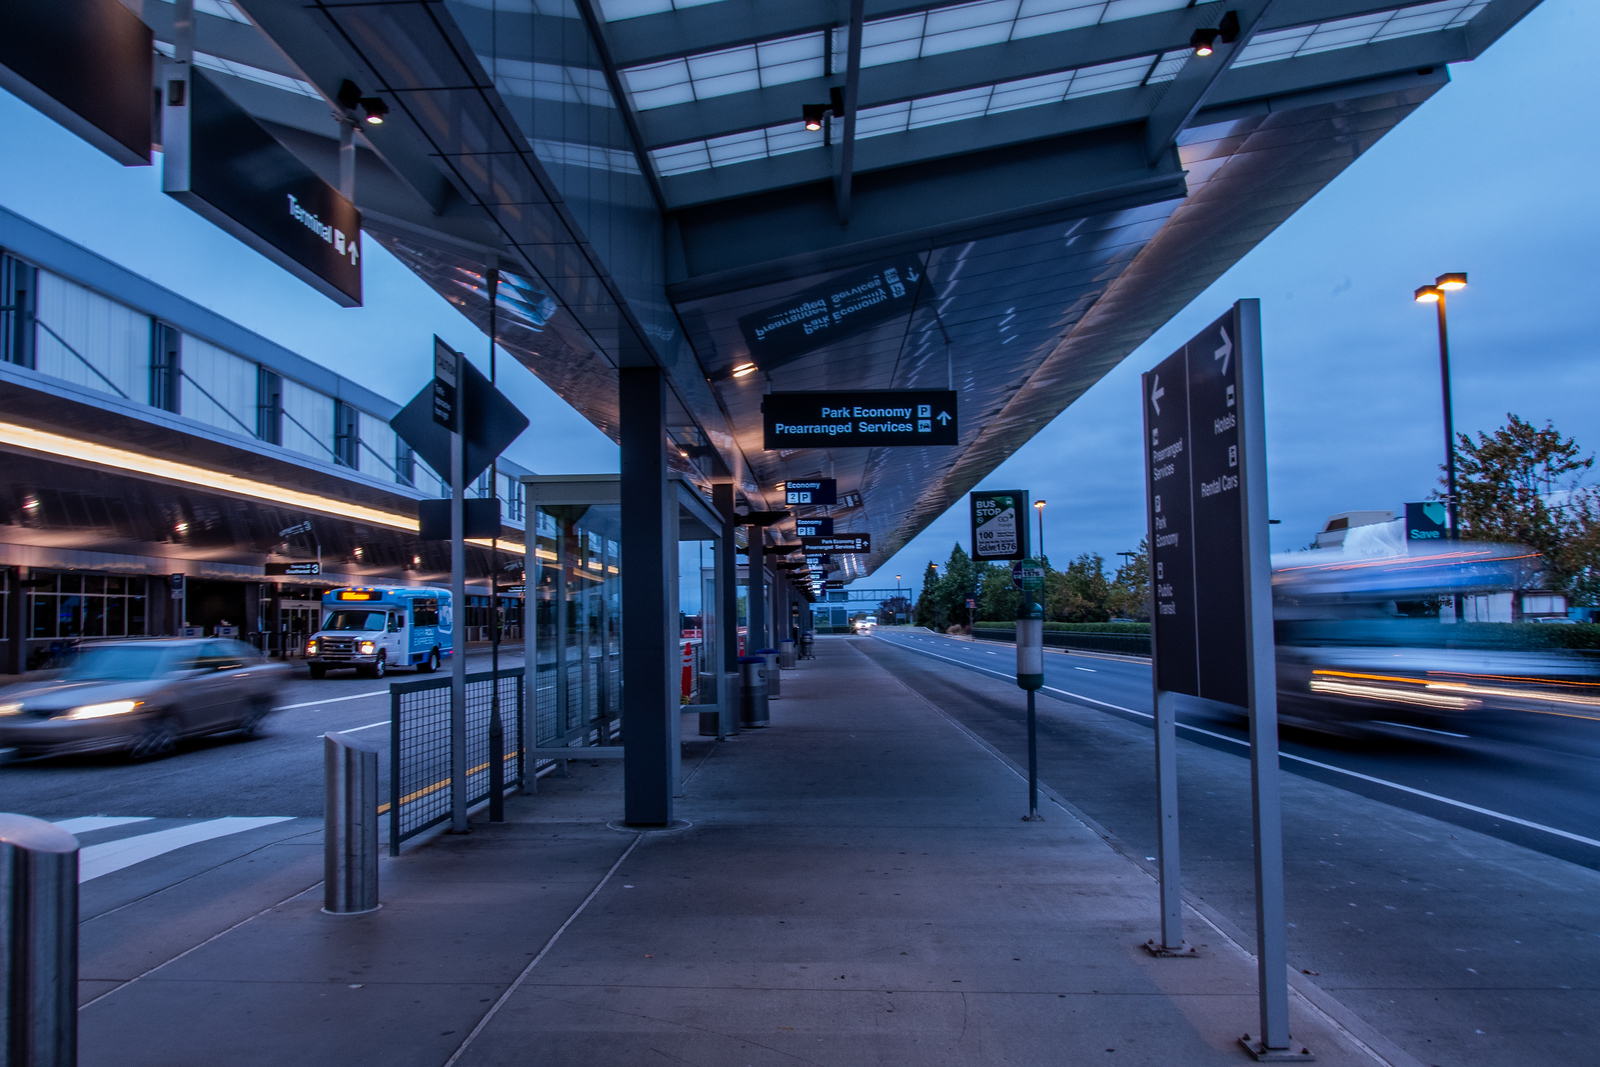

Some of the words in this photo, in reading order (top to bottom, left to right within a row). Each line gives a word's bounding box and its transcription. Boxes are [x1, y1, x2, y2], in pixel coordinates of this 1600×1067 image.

[287, 193, 333, 244] Terminal
[821, 407, 851, 418] Park
[853, 406, 912, 419] Economy
[775, 422, 852, 436] Prearranged
[858, 421, 913, 433] Services
[1214, 412, 1236, 435] Hotels
[1153, 437, 1183, 464] Prearranged
[1153, 463, 1175, 481] Services
[787, 482, 821, 490] Economy
[1201, 477, 1221, 498] Rental
[1222, 475, 1238, 491] Cars
[976, 500, 996, 508] BUS
[976, 508, 1002, 517] STOP
[1155, 515, 1167, 530] Park
[979, 531, 993, 539] 100
[1156, 533, 1179, 547] Economy
[1410, 529, 1440, 539] Save
[996, 542, 1017, 551] 1576
[311, 564, 320, 574] 3
[1158, 583, 1173, 597] Public
[1159, 601, 1176, 615] Transit
